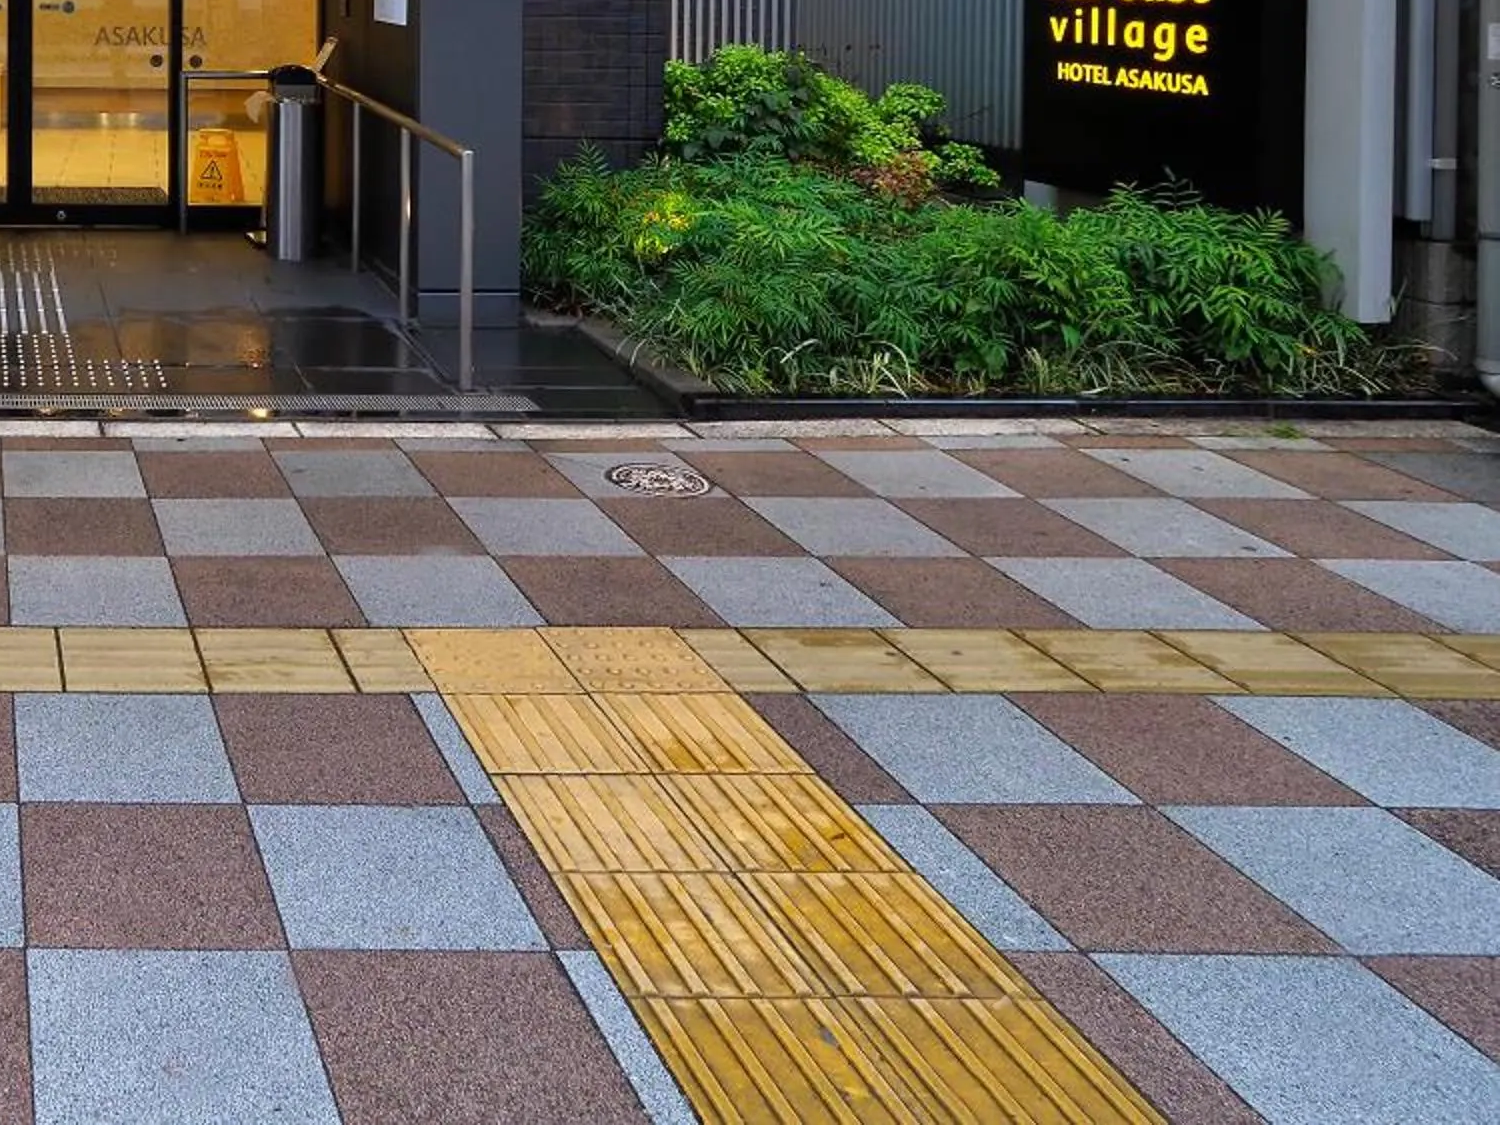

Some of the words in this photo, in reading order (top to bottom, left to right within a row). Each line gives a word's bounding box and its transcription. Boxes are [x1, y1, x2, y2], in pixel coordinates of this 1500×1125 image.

[1049, 6, 1209, 62] village
[1057, 62, 1112, 85] HOTEL
[1115, 66, 1209, 96] ASAKUSA
